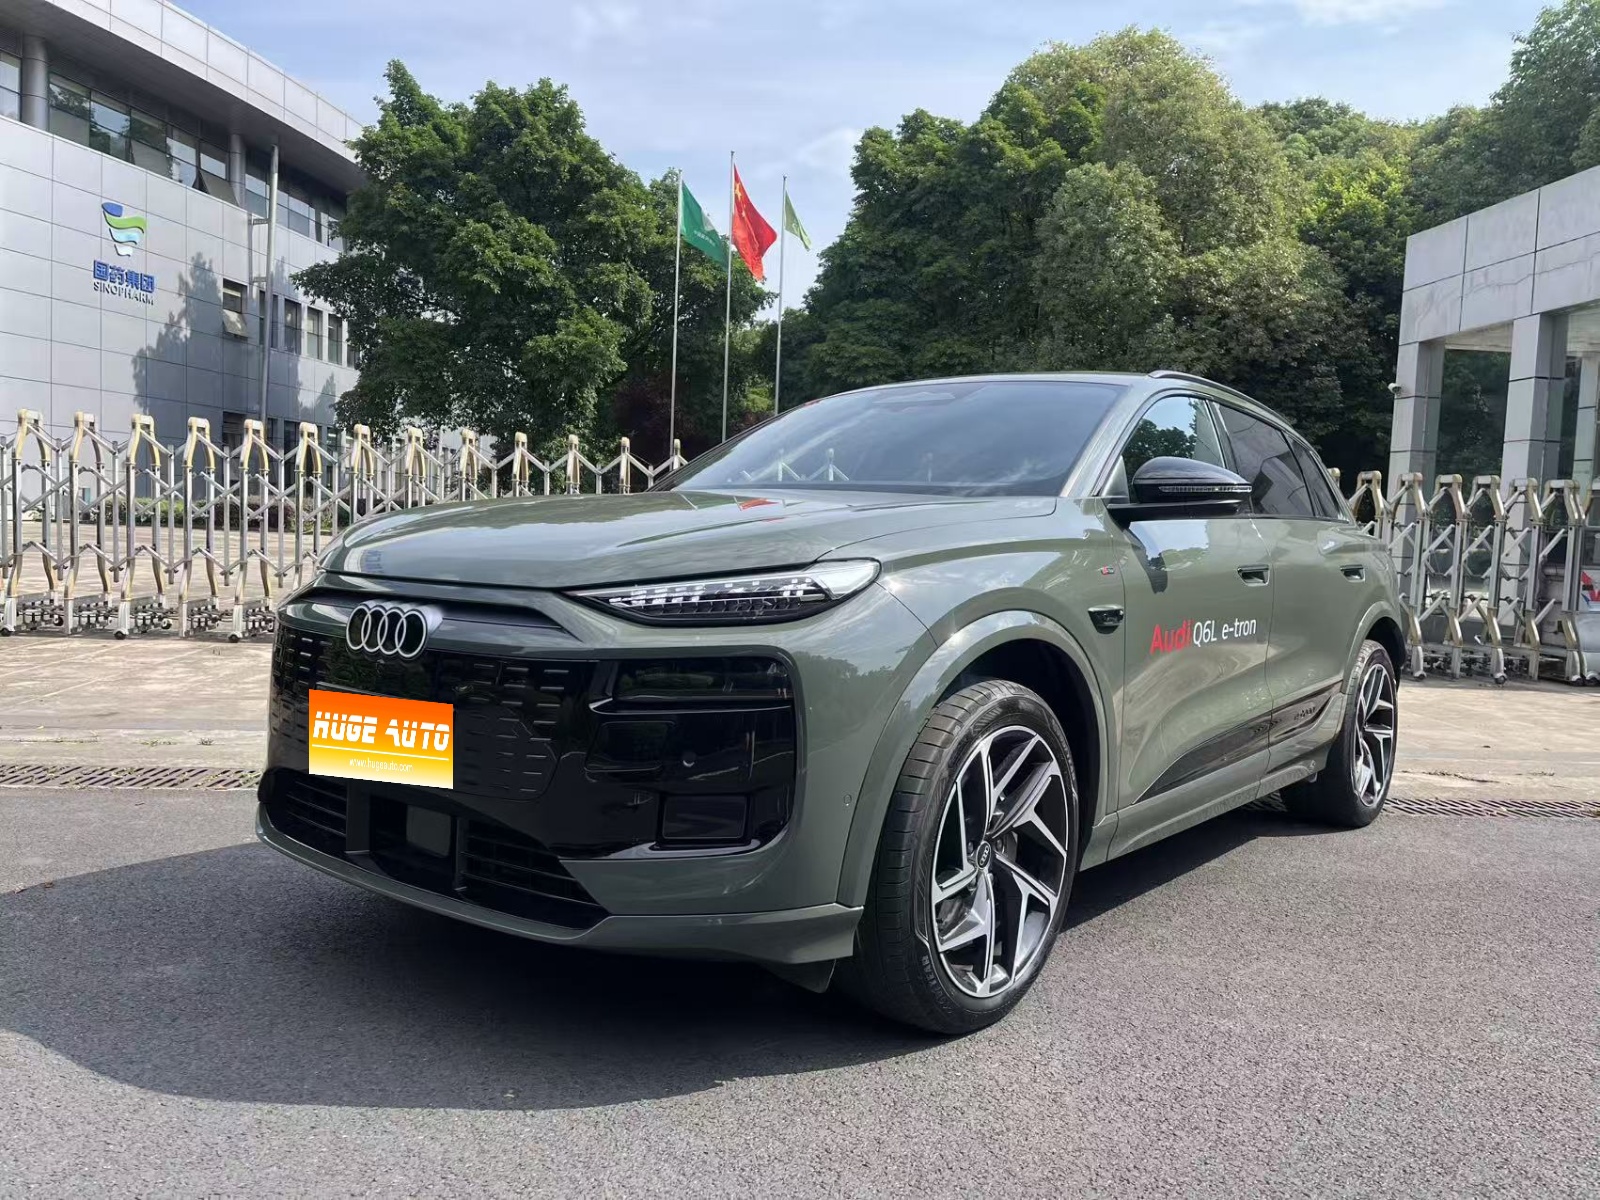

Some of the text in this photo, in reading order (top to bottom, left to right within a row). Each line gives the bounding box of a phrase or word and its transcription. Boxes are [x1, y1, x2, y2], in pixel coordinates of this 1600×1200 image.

[93, 260, 154, 293] 国药集团
[93, 282, 154, 305] SINOPHARM
[1150, 617, 1257, 654] Audi Q6L e-tron
